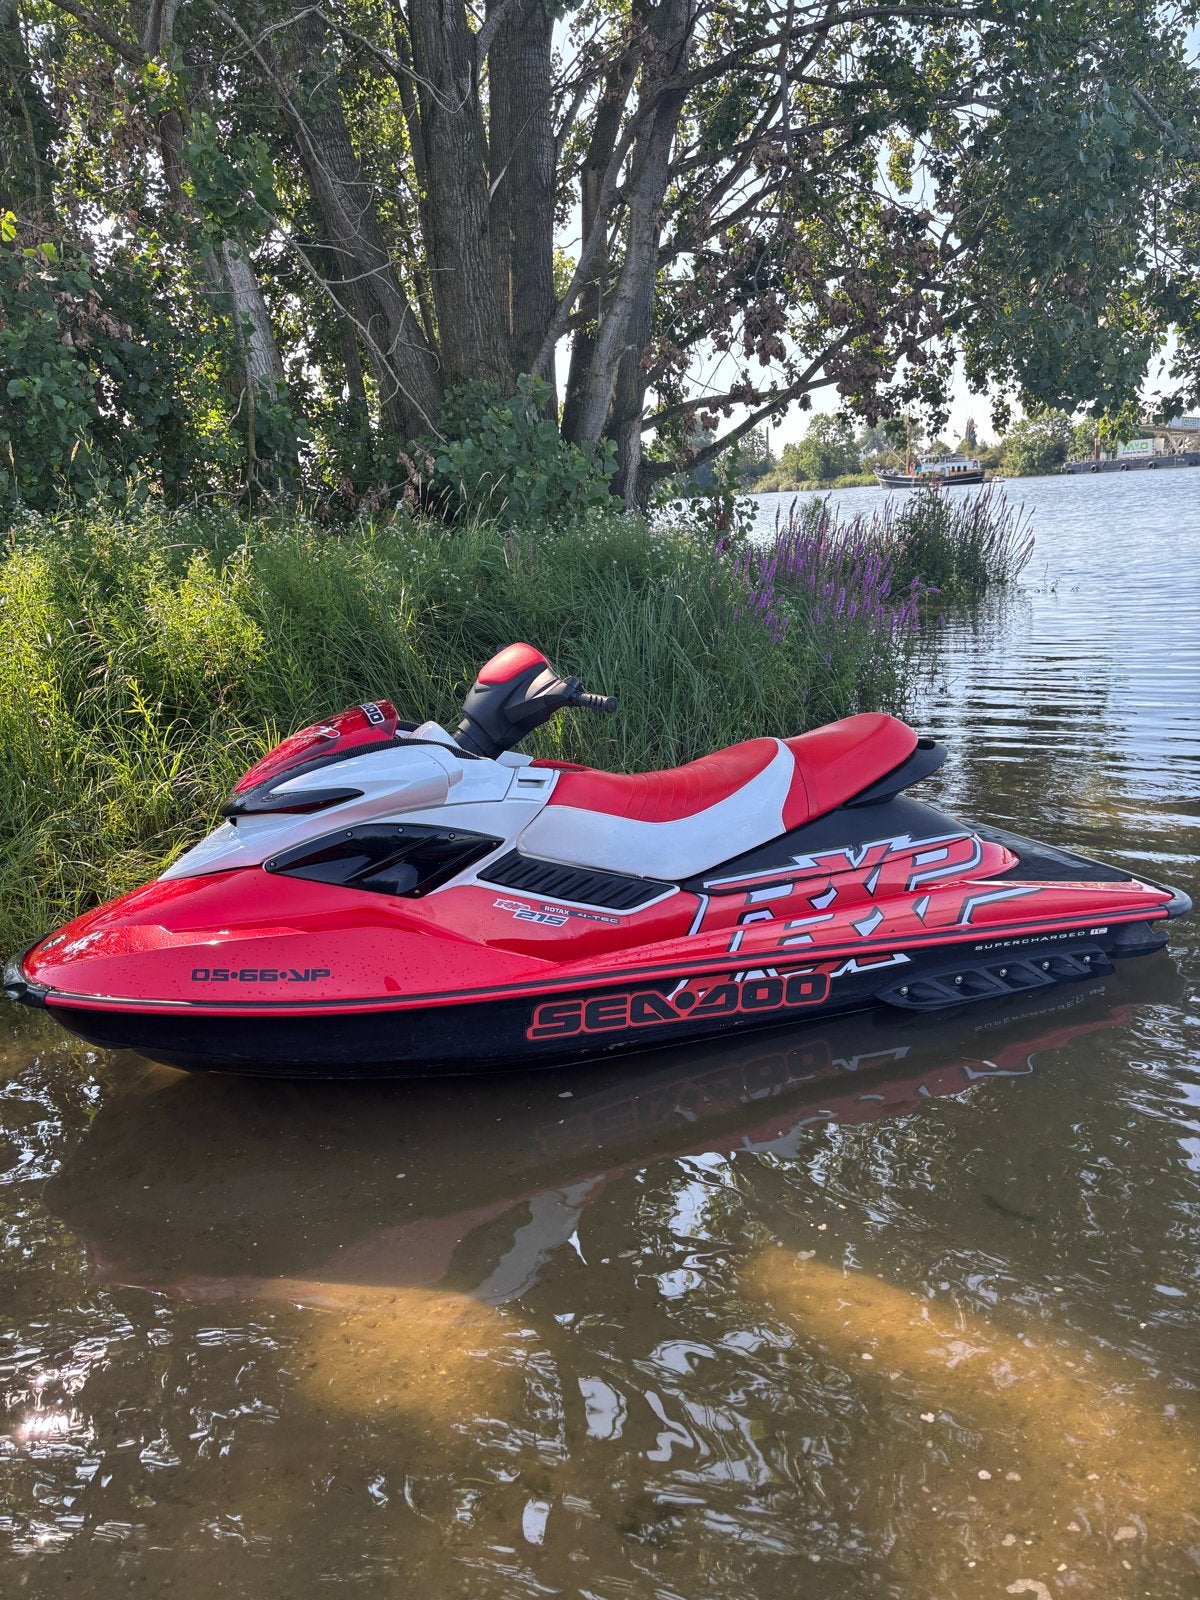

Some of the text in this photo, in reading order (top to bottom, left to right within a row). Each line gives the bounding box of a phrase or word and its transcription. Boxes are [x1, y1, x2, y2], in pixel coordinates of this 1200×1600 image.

[512, 909, 569, 926] 215
[543, 906, 619, 924] ROTAX 4-TEC
[974, 930, 1085, 951] SUPERCHARGED
